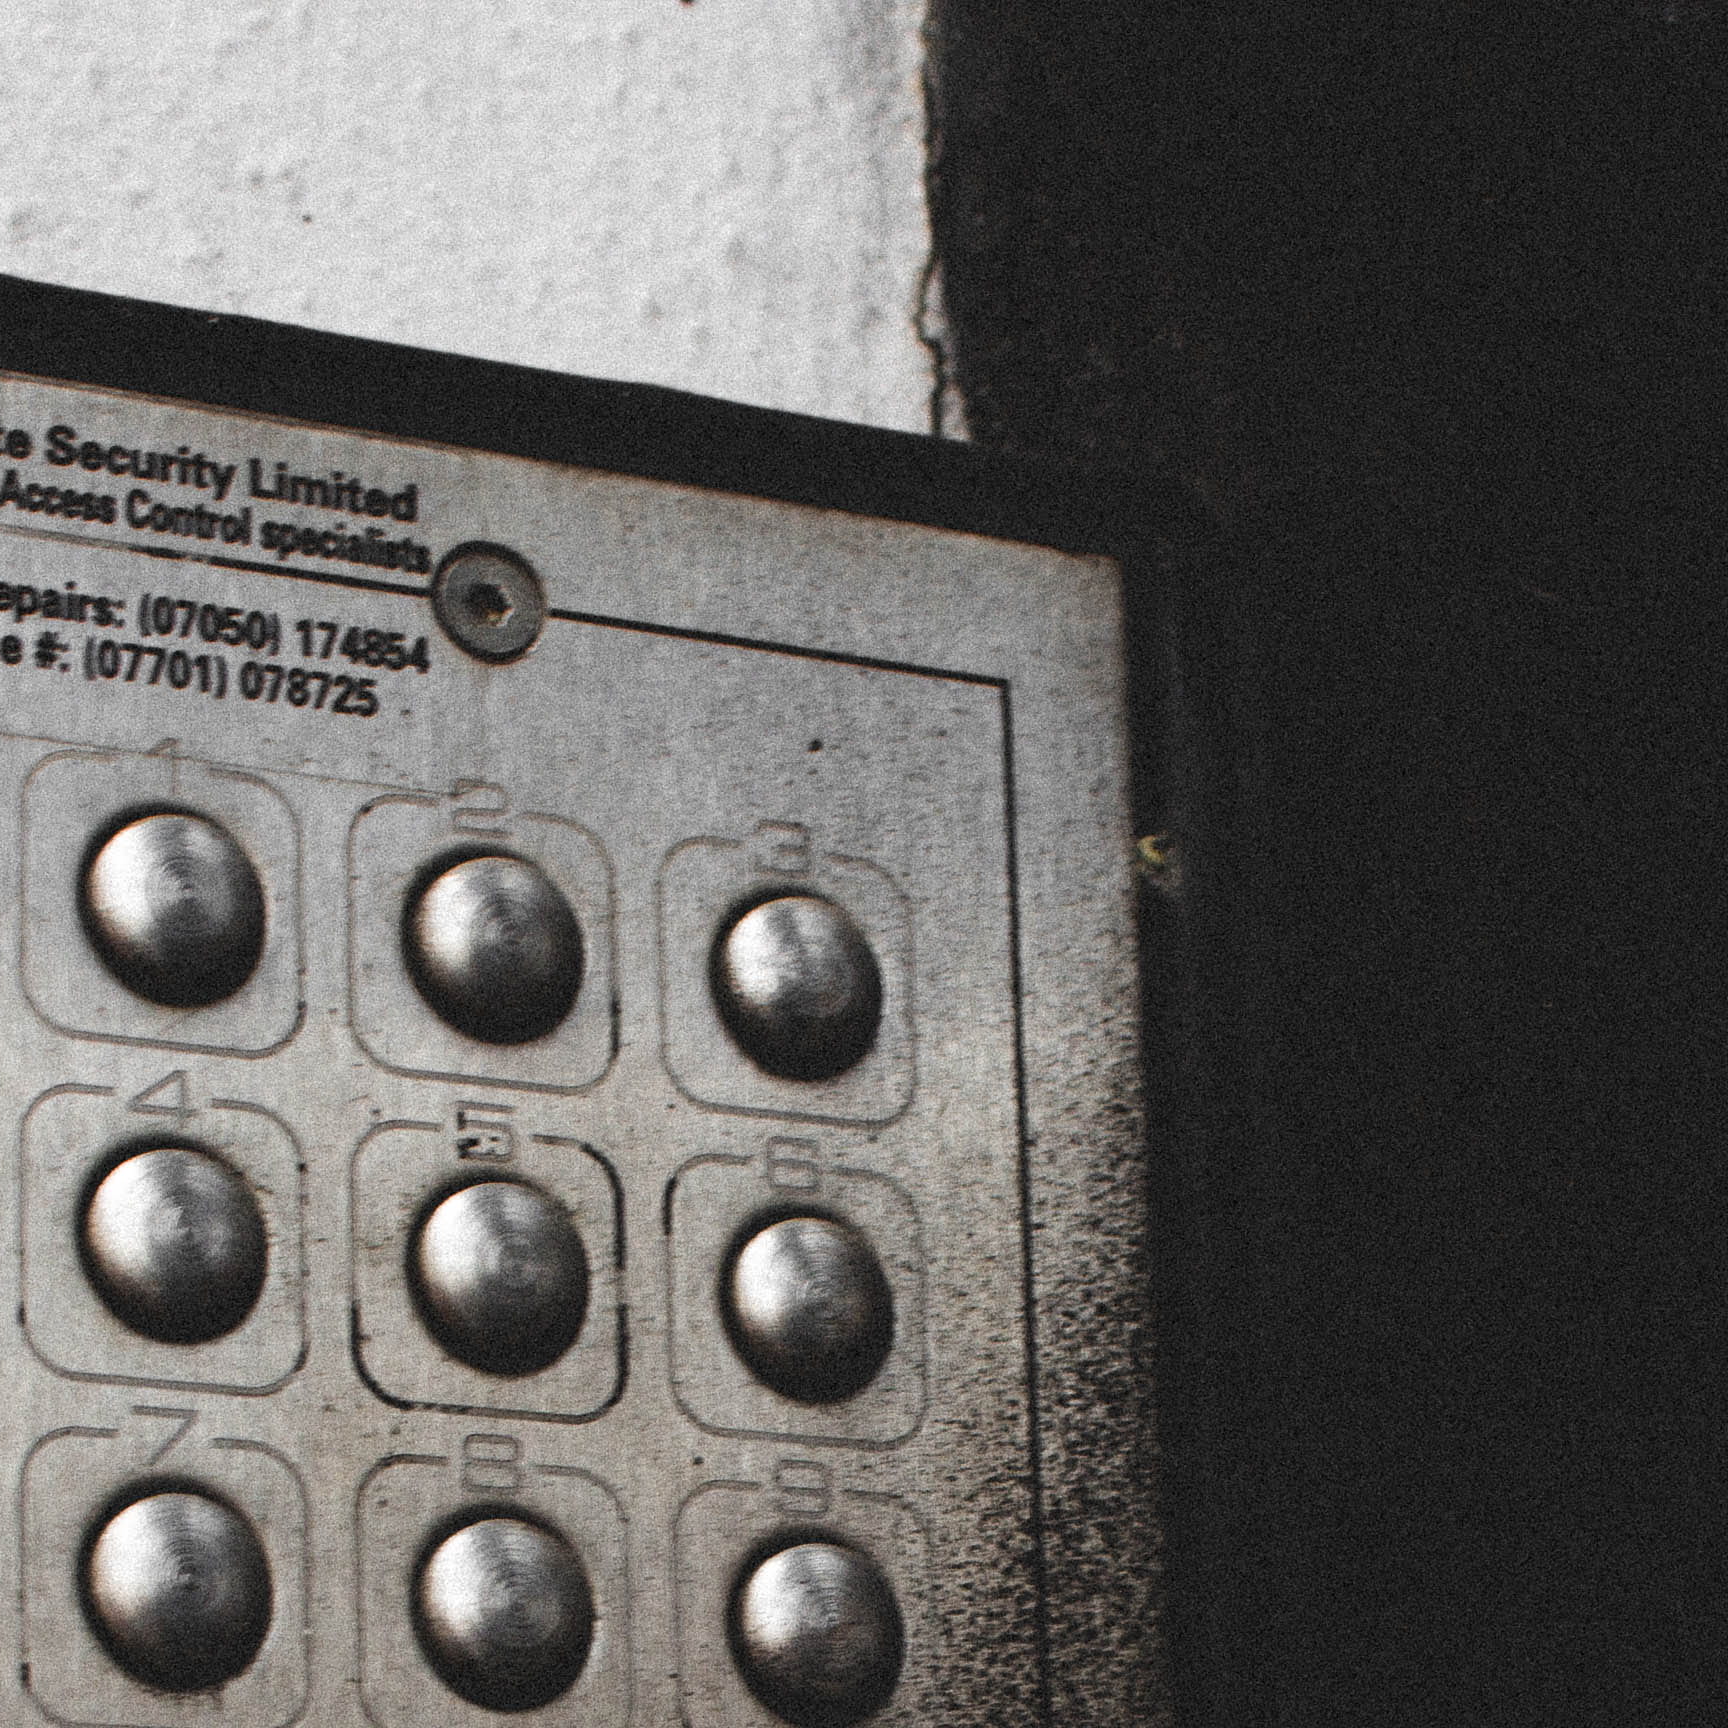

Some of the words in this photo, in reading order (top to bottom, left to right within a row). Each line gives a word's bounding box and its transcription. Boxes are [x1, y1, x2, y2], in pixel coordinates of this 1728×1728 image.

[45, 424, 237, 502] Security
[248, 457, 419, 523] Limited
[125, 488, 252, 546] Control
[260, 518, 432, 574] specialists
[137, 593, 281, 658] (07050)
[295, 618, 431, 675] 174854
[83, 635, 229, 700] (07701)
[239, 659, 380, 718] 078725
[127, 1069, 194, 1120] 4
[132, 1404, 199, 1466] 7
[461, 1433, 520, 1492] 8
